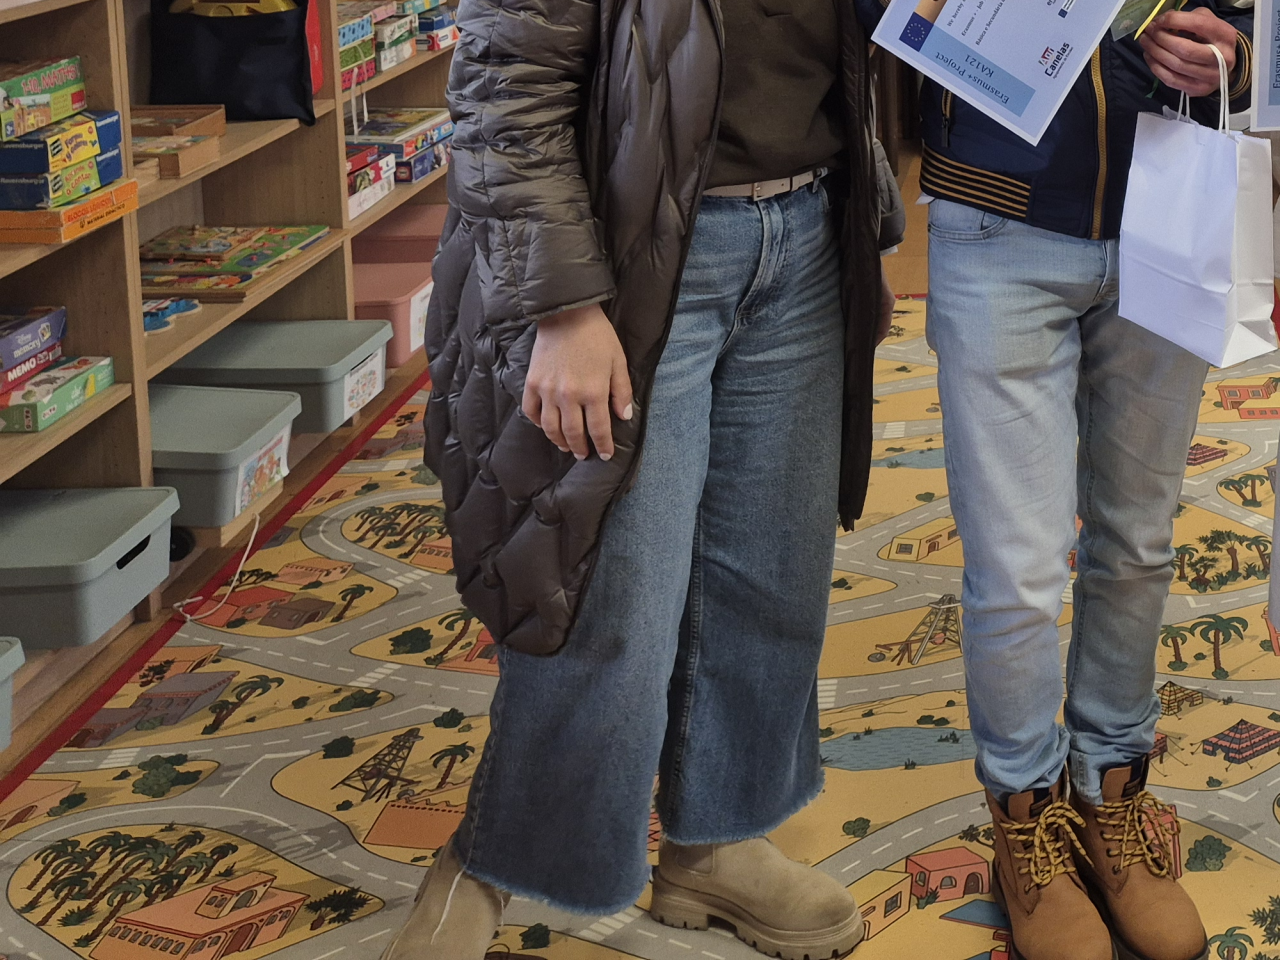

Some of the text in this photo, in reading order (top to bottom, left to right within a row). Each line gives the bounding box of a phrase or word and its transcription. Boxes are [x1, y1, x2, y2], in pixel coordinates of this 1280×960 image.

[946, 18, 954, 27] We
[951, 2, 964, 19] hereby
[961, 16, 975, 36] Erasmus
[975, 30, 986, 46] Básica
[985, 2, 1003, 27] Secundária
[964, 54, 994, 78] KA121
[1044, 42, 1070, 77] Canelas
[935, 52, 1010, 104] Erasmus+ Project
[13, 338, 41, 358] memory
[8, 358, 36, 382] MEMO
